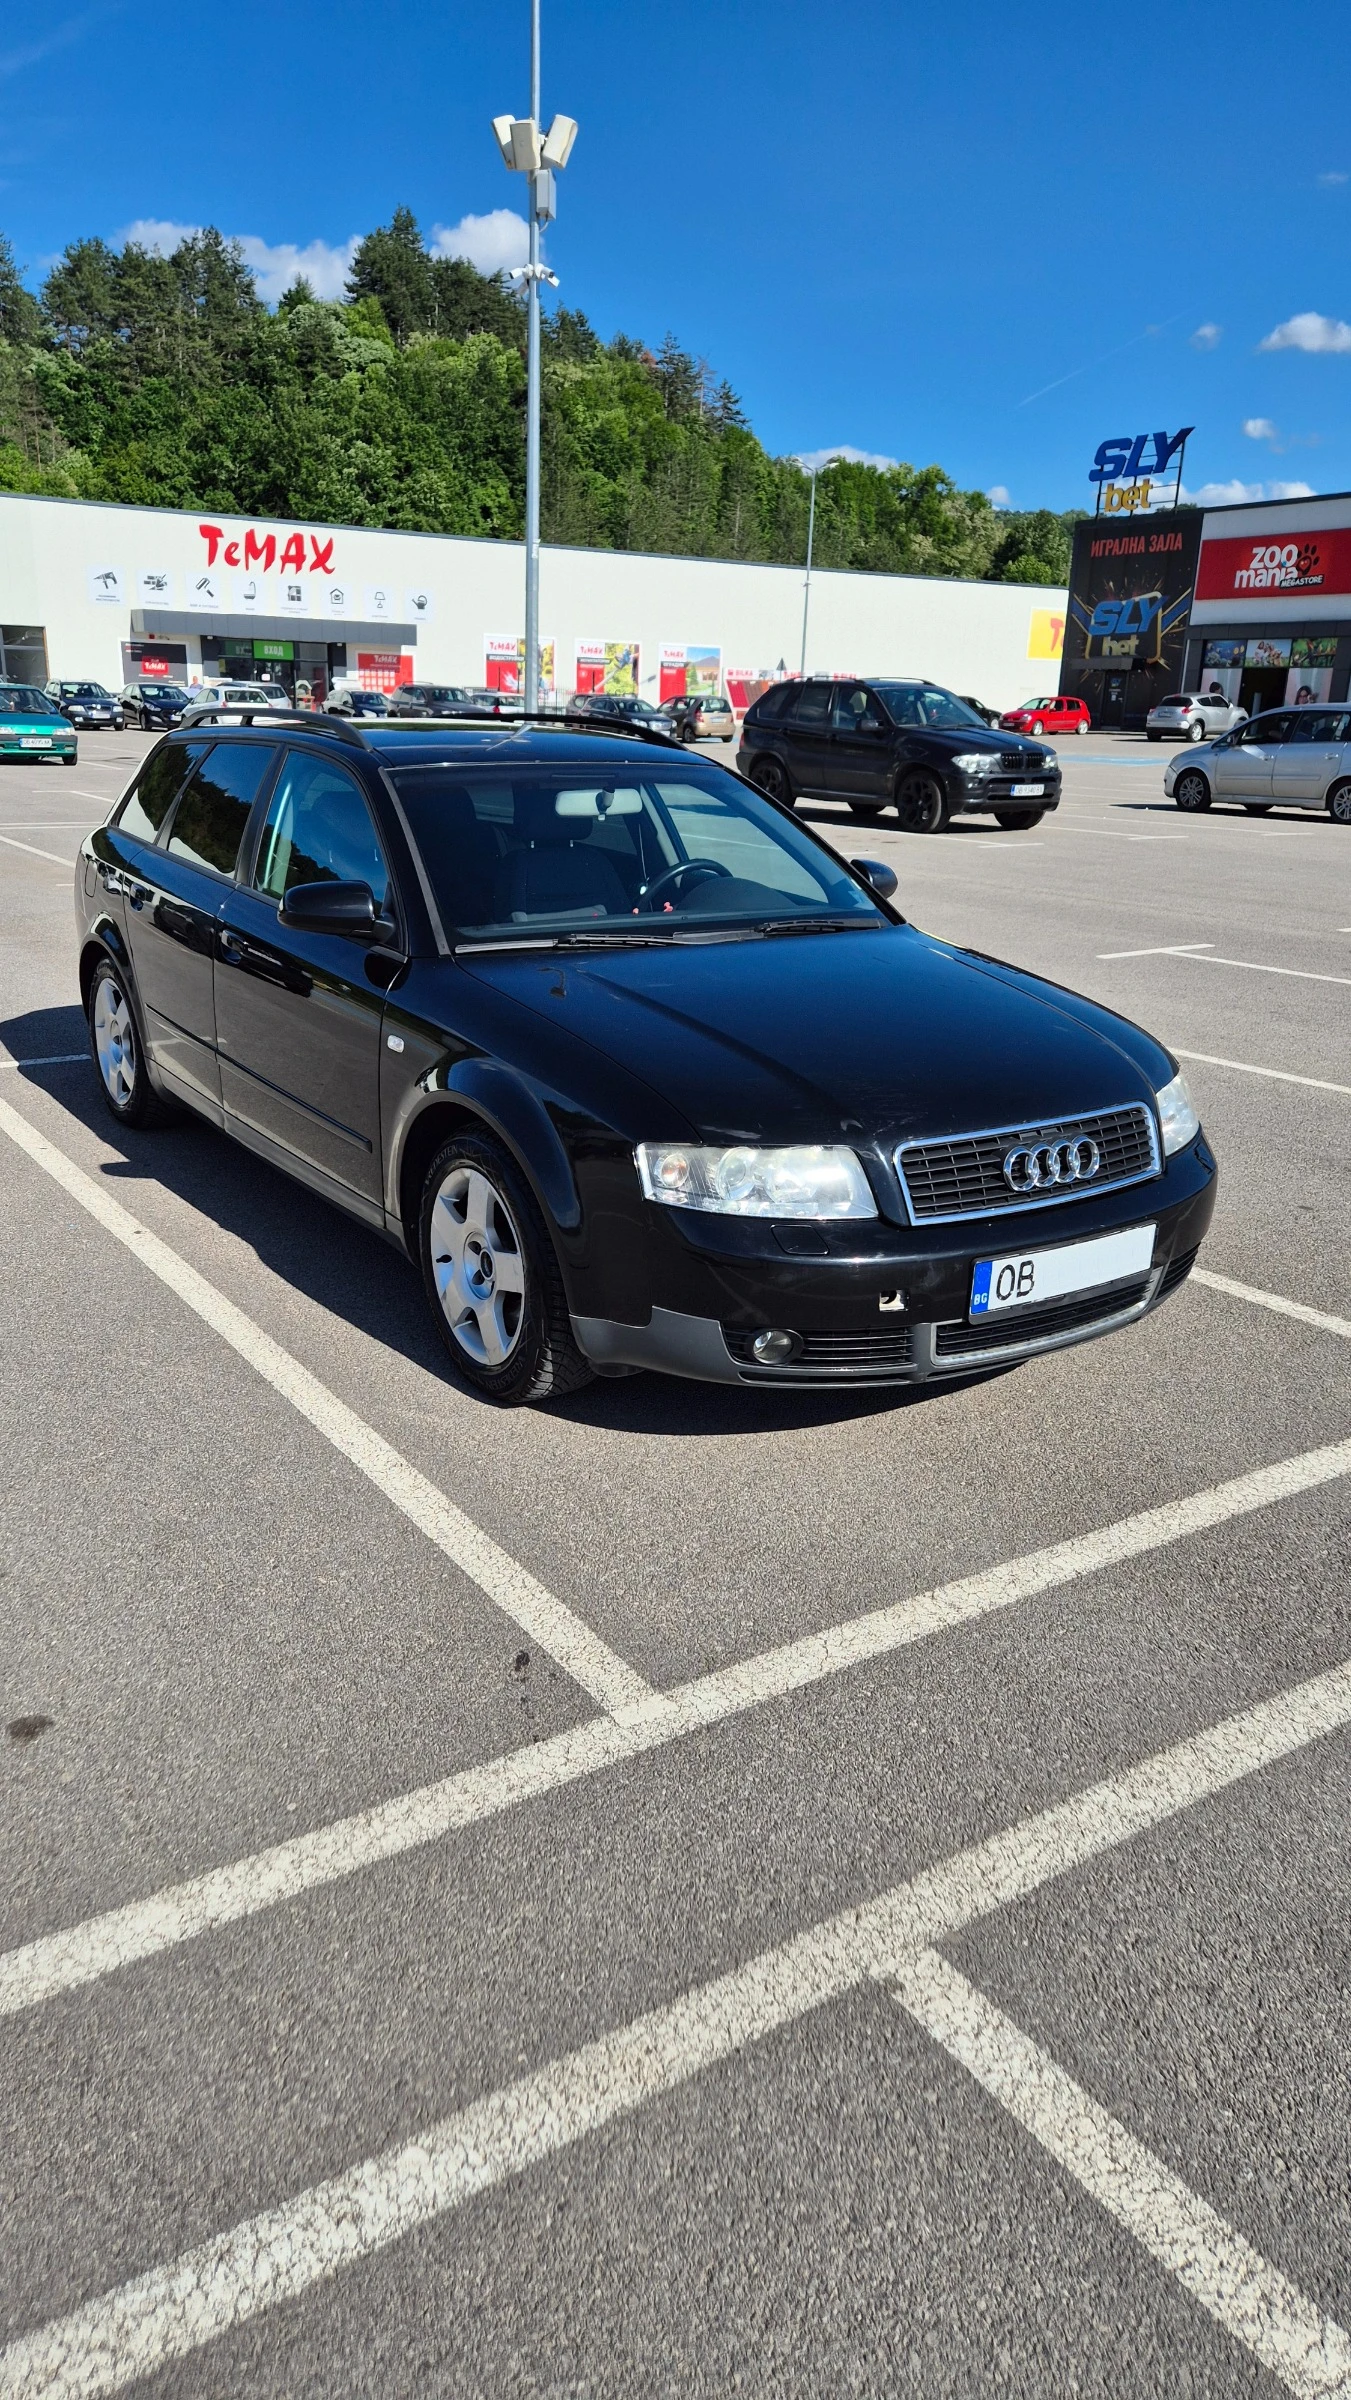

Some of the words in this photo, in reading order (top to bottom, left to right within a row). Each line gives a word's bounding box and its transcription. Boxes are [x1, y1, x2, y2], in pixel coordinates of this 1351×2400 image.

[1088, 426, 1195, 482] SLY
[1105, 478, 1153, 512] bet
[199, 524, 335, 574] TeMAX
[1091, 535, 1145, 557] ИГРАЛНА
[1149, 532, 1183, 552] ЗАЛА
[1234, 566, 1298, 588] mania
[1280, 575, 1323, 588] MEGASTORE
[1088, 595, 1170, 635] SLY
[263, 645, 284, 656] ВХОД
[995, 1259, 1035, 1301] OB
[973, 1292, 988, 1306] BG
